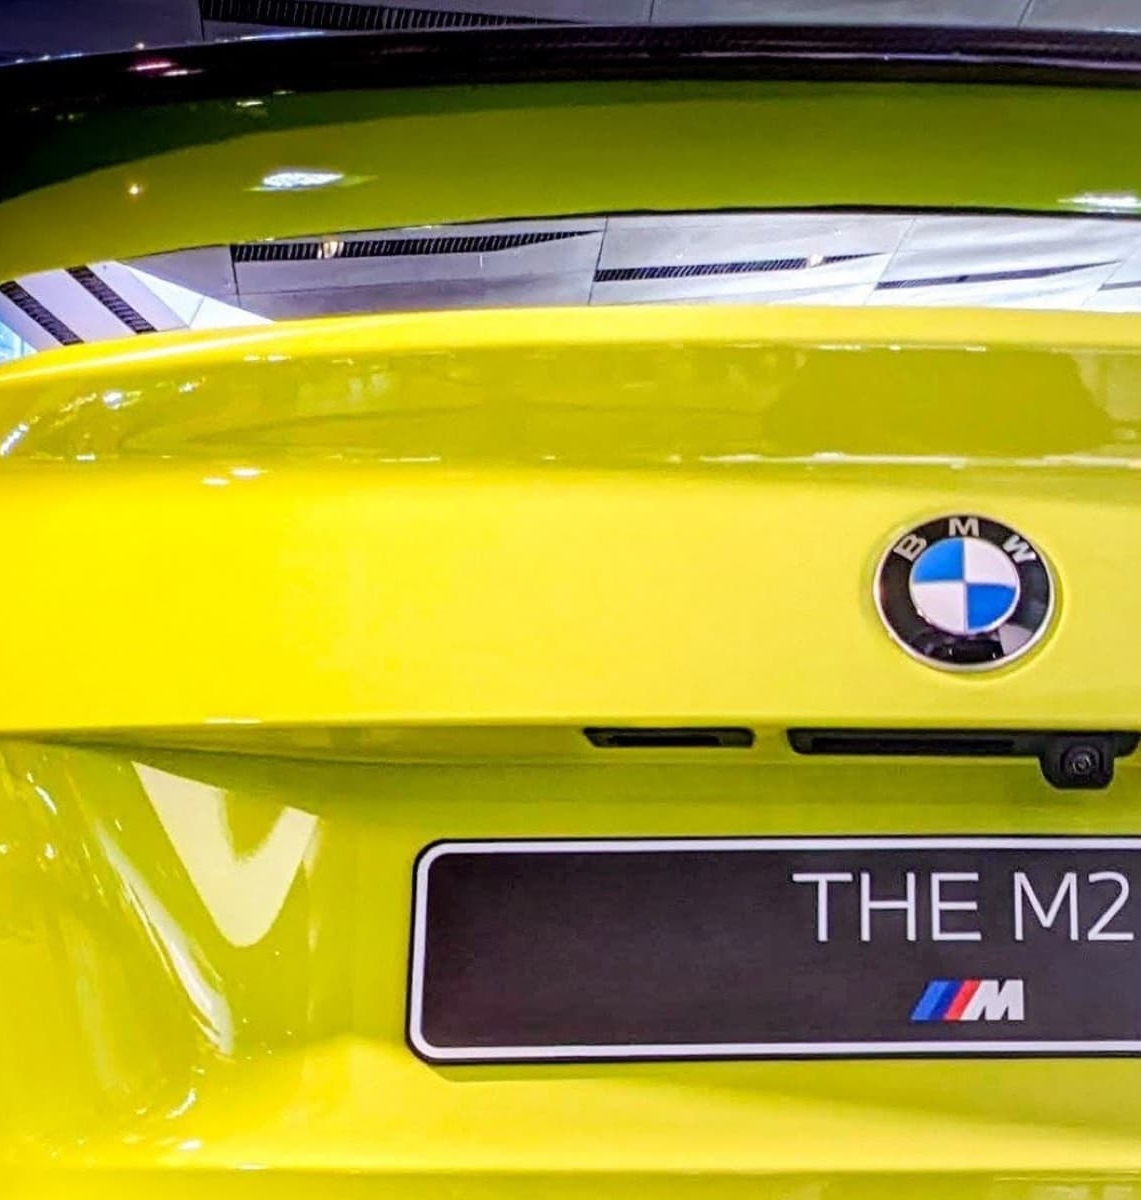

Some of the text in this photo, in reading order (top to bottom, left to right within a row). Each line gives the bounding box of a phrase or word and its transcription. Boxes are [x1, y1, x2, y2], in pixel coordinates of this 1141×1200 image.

[893, 517, 1037, 563] BMW
[792, 870, 1135, 942] THE M2
[959, 979, 1025, 1021] M
